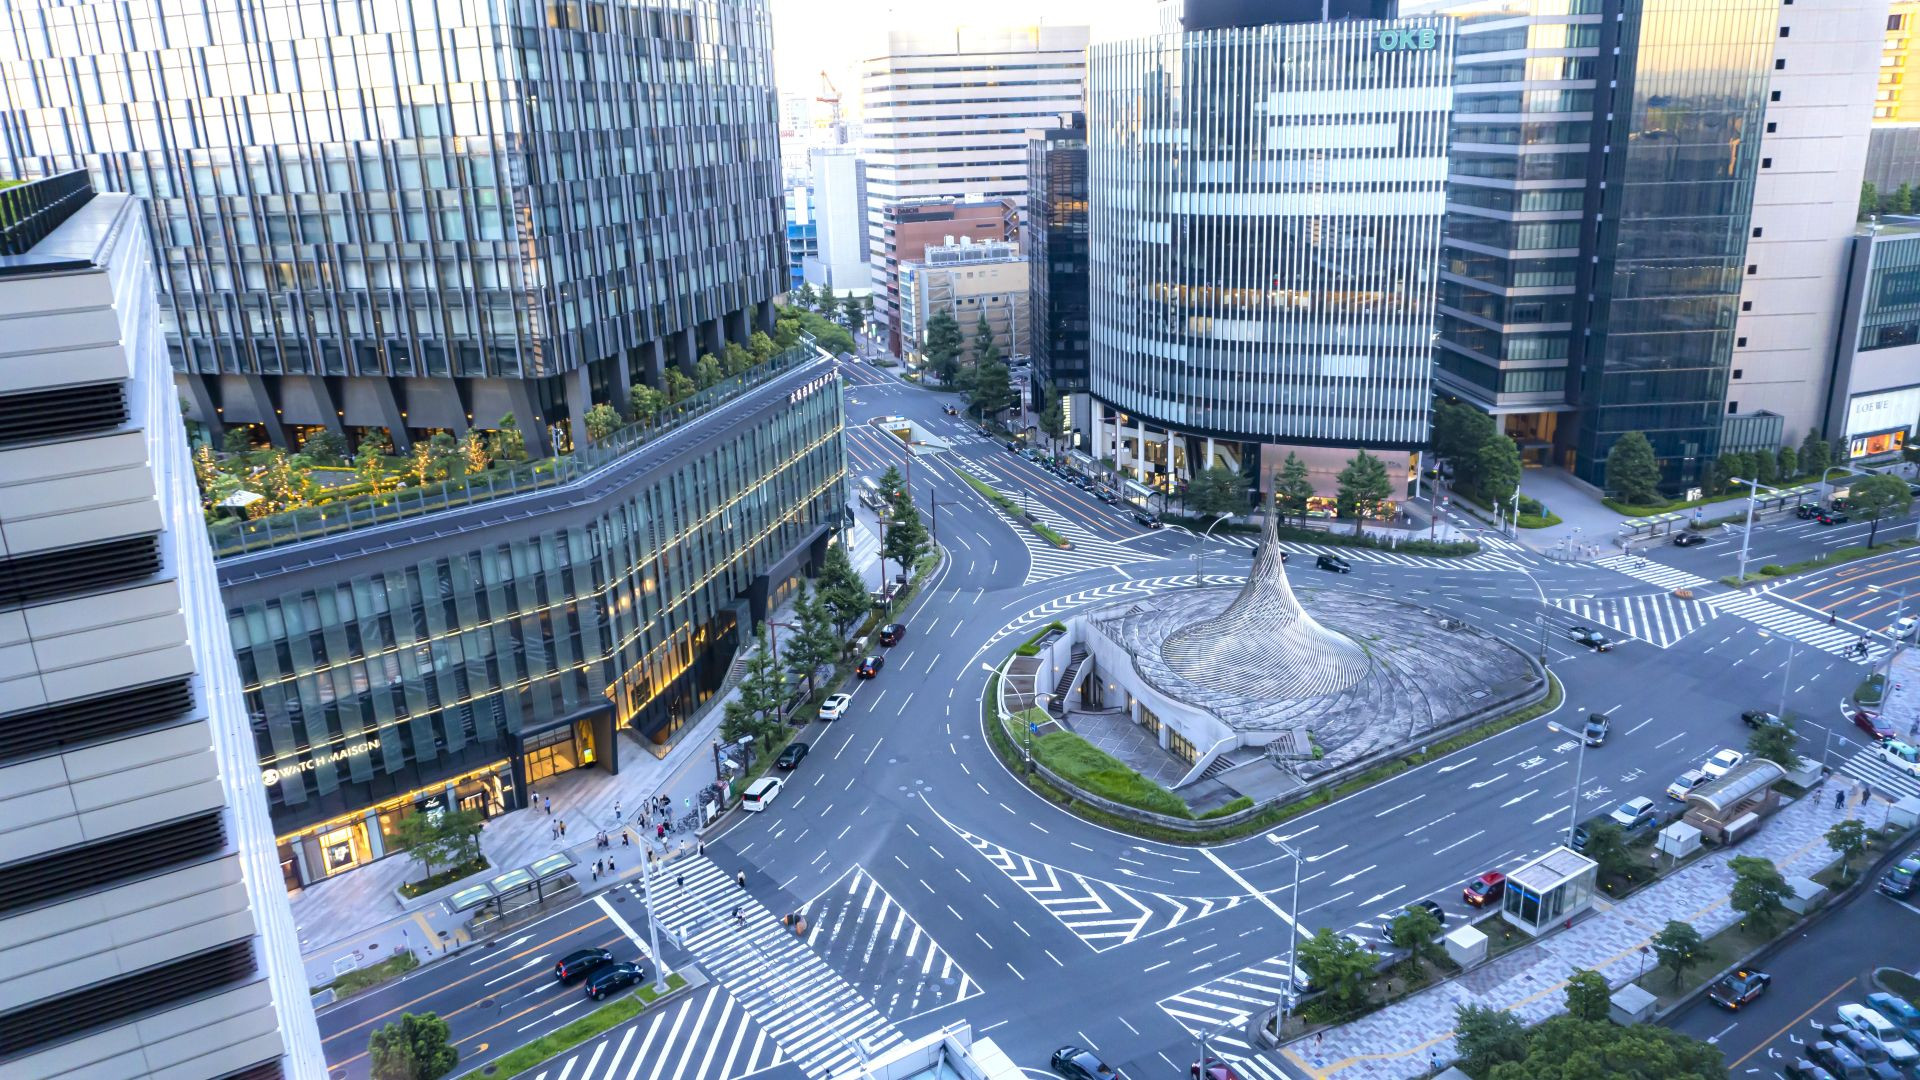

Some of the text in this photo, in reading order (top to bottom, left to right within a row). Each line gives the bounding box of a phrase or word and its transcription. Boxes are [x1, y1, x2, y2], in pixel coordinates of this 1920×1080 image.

[1379, 28, 1436, 50] OKB
[1856, 400, 1889, 414] LOEWE
[278, 739, 381, 777] WATCH MAISON
